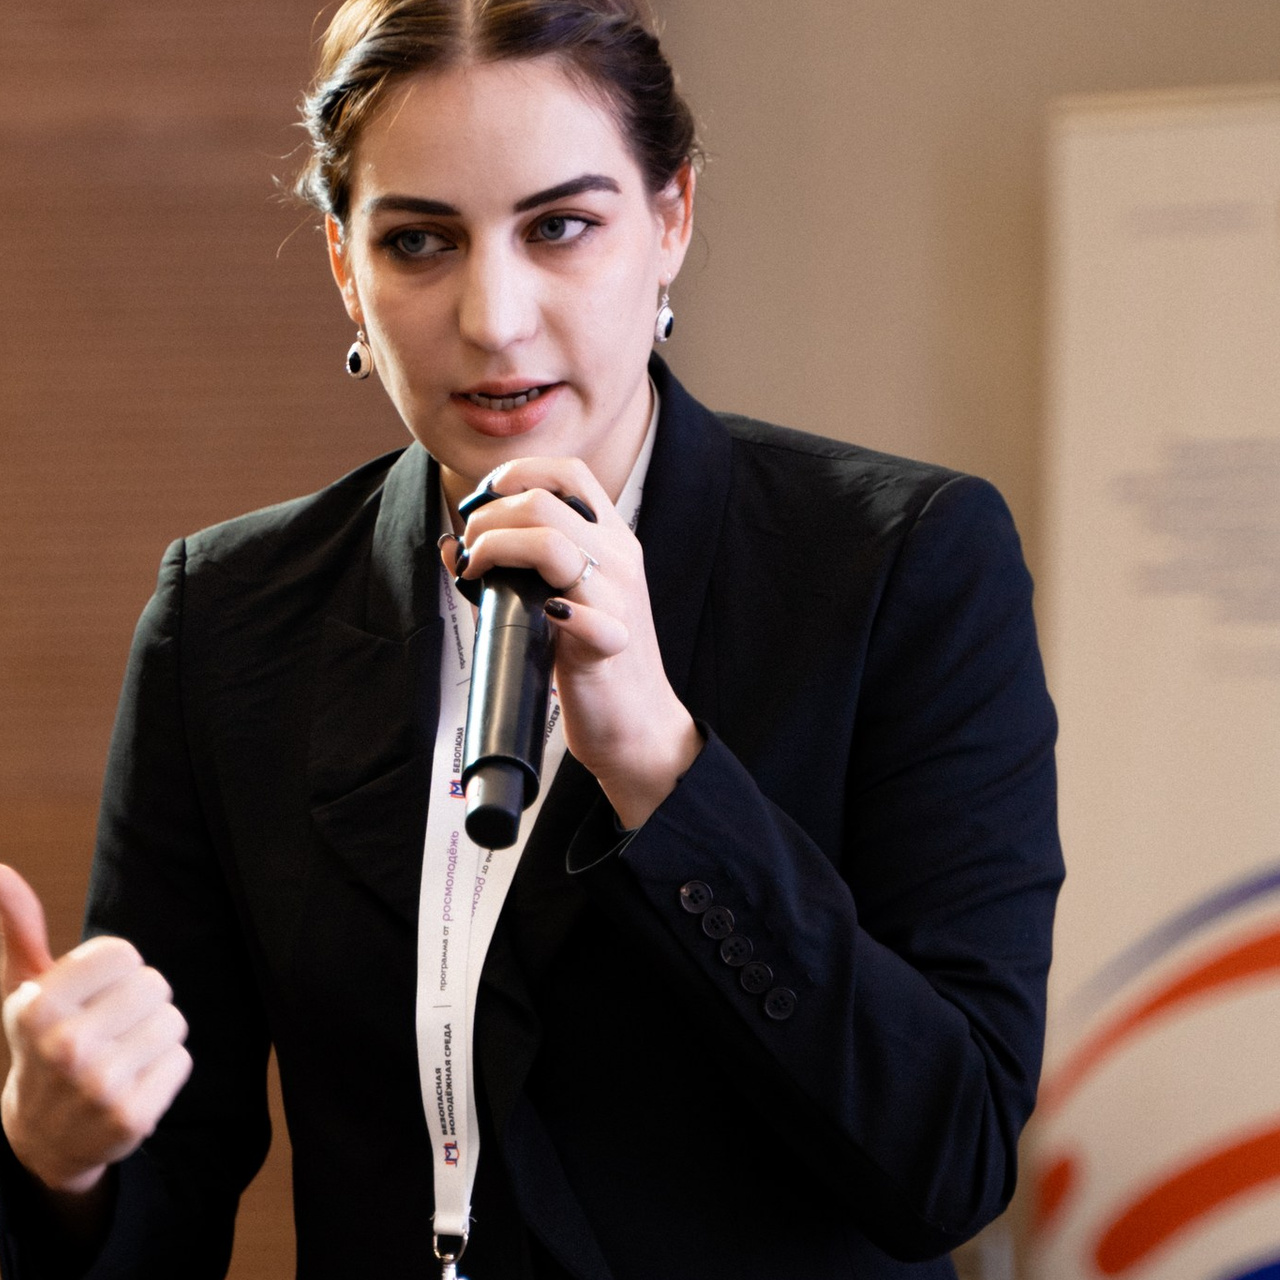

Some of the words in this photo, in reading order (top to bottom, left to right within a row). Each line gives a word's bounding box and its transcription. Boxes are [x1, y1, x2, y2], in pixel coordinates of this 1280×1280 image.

[453, 727, 464, 773] БЕЗОПАСНАЯ
[442, 830, 460, 922] росмолодёжь
[482, 865, 489, 874] от
[443, 926, 448, 936] от
[440, 939, 448, 991] программа
[444, 1023, 452, 1057] СРЕДА
[435, 1067, 447, 1135] БЕЗОПАСНАЯ
[444, 1060, 456, 1136] МОЛОДЁЖНАЯ
